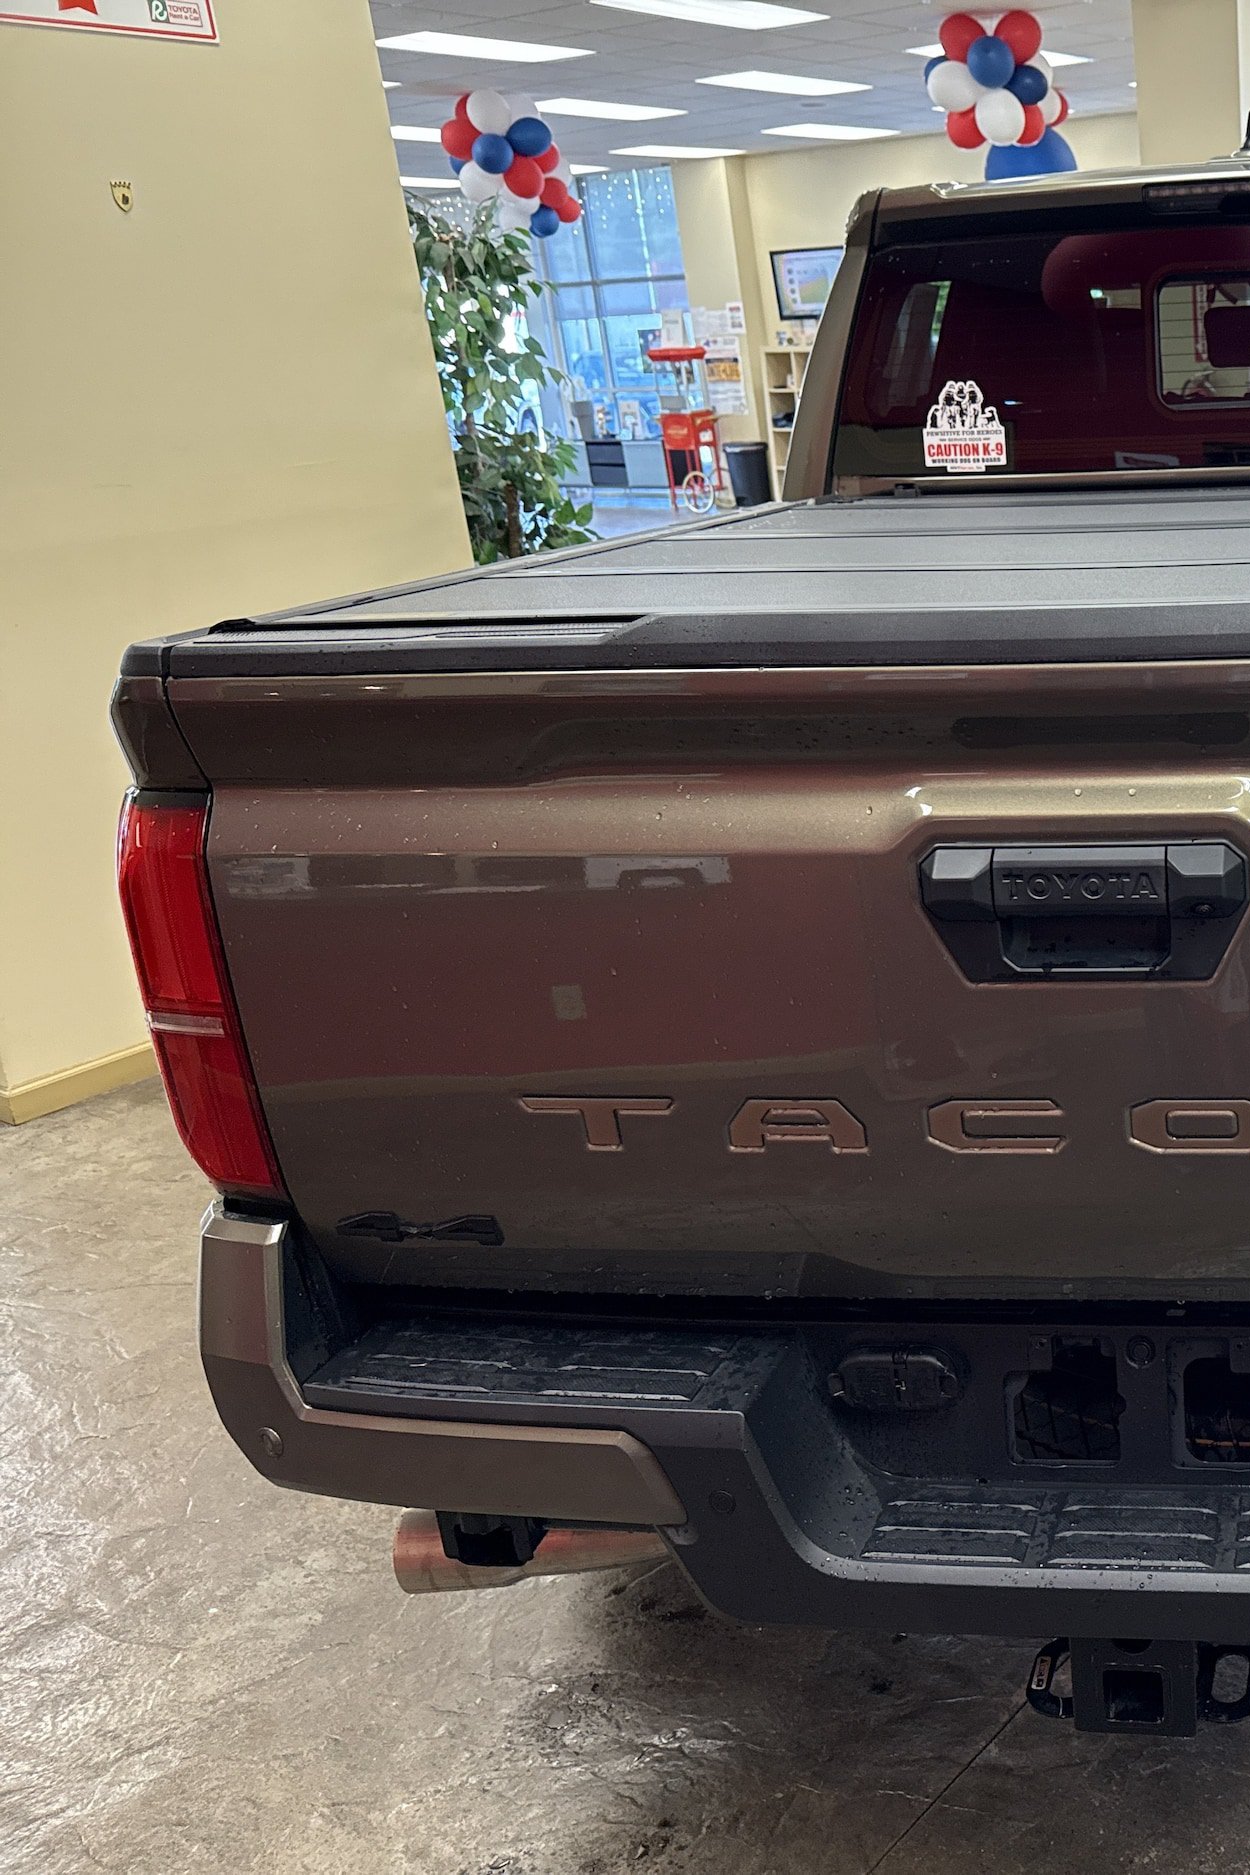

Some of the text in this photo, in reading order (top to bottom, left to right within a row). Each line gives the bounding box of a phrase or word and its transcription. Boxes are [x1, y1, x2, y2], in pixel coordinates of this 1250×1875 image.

[168, 5, 198, 14] TOYOTA
[927, 443, 1003, 457] CAUTION K-9
[1002, 871, 1159, 900] TOYOTA
